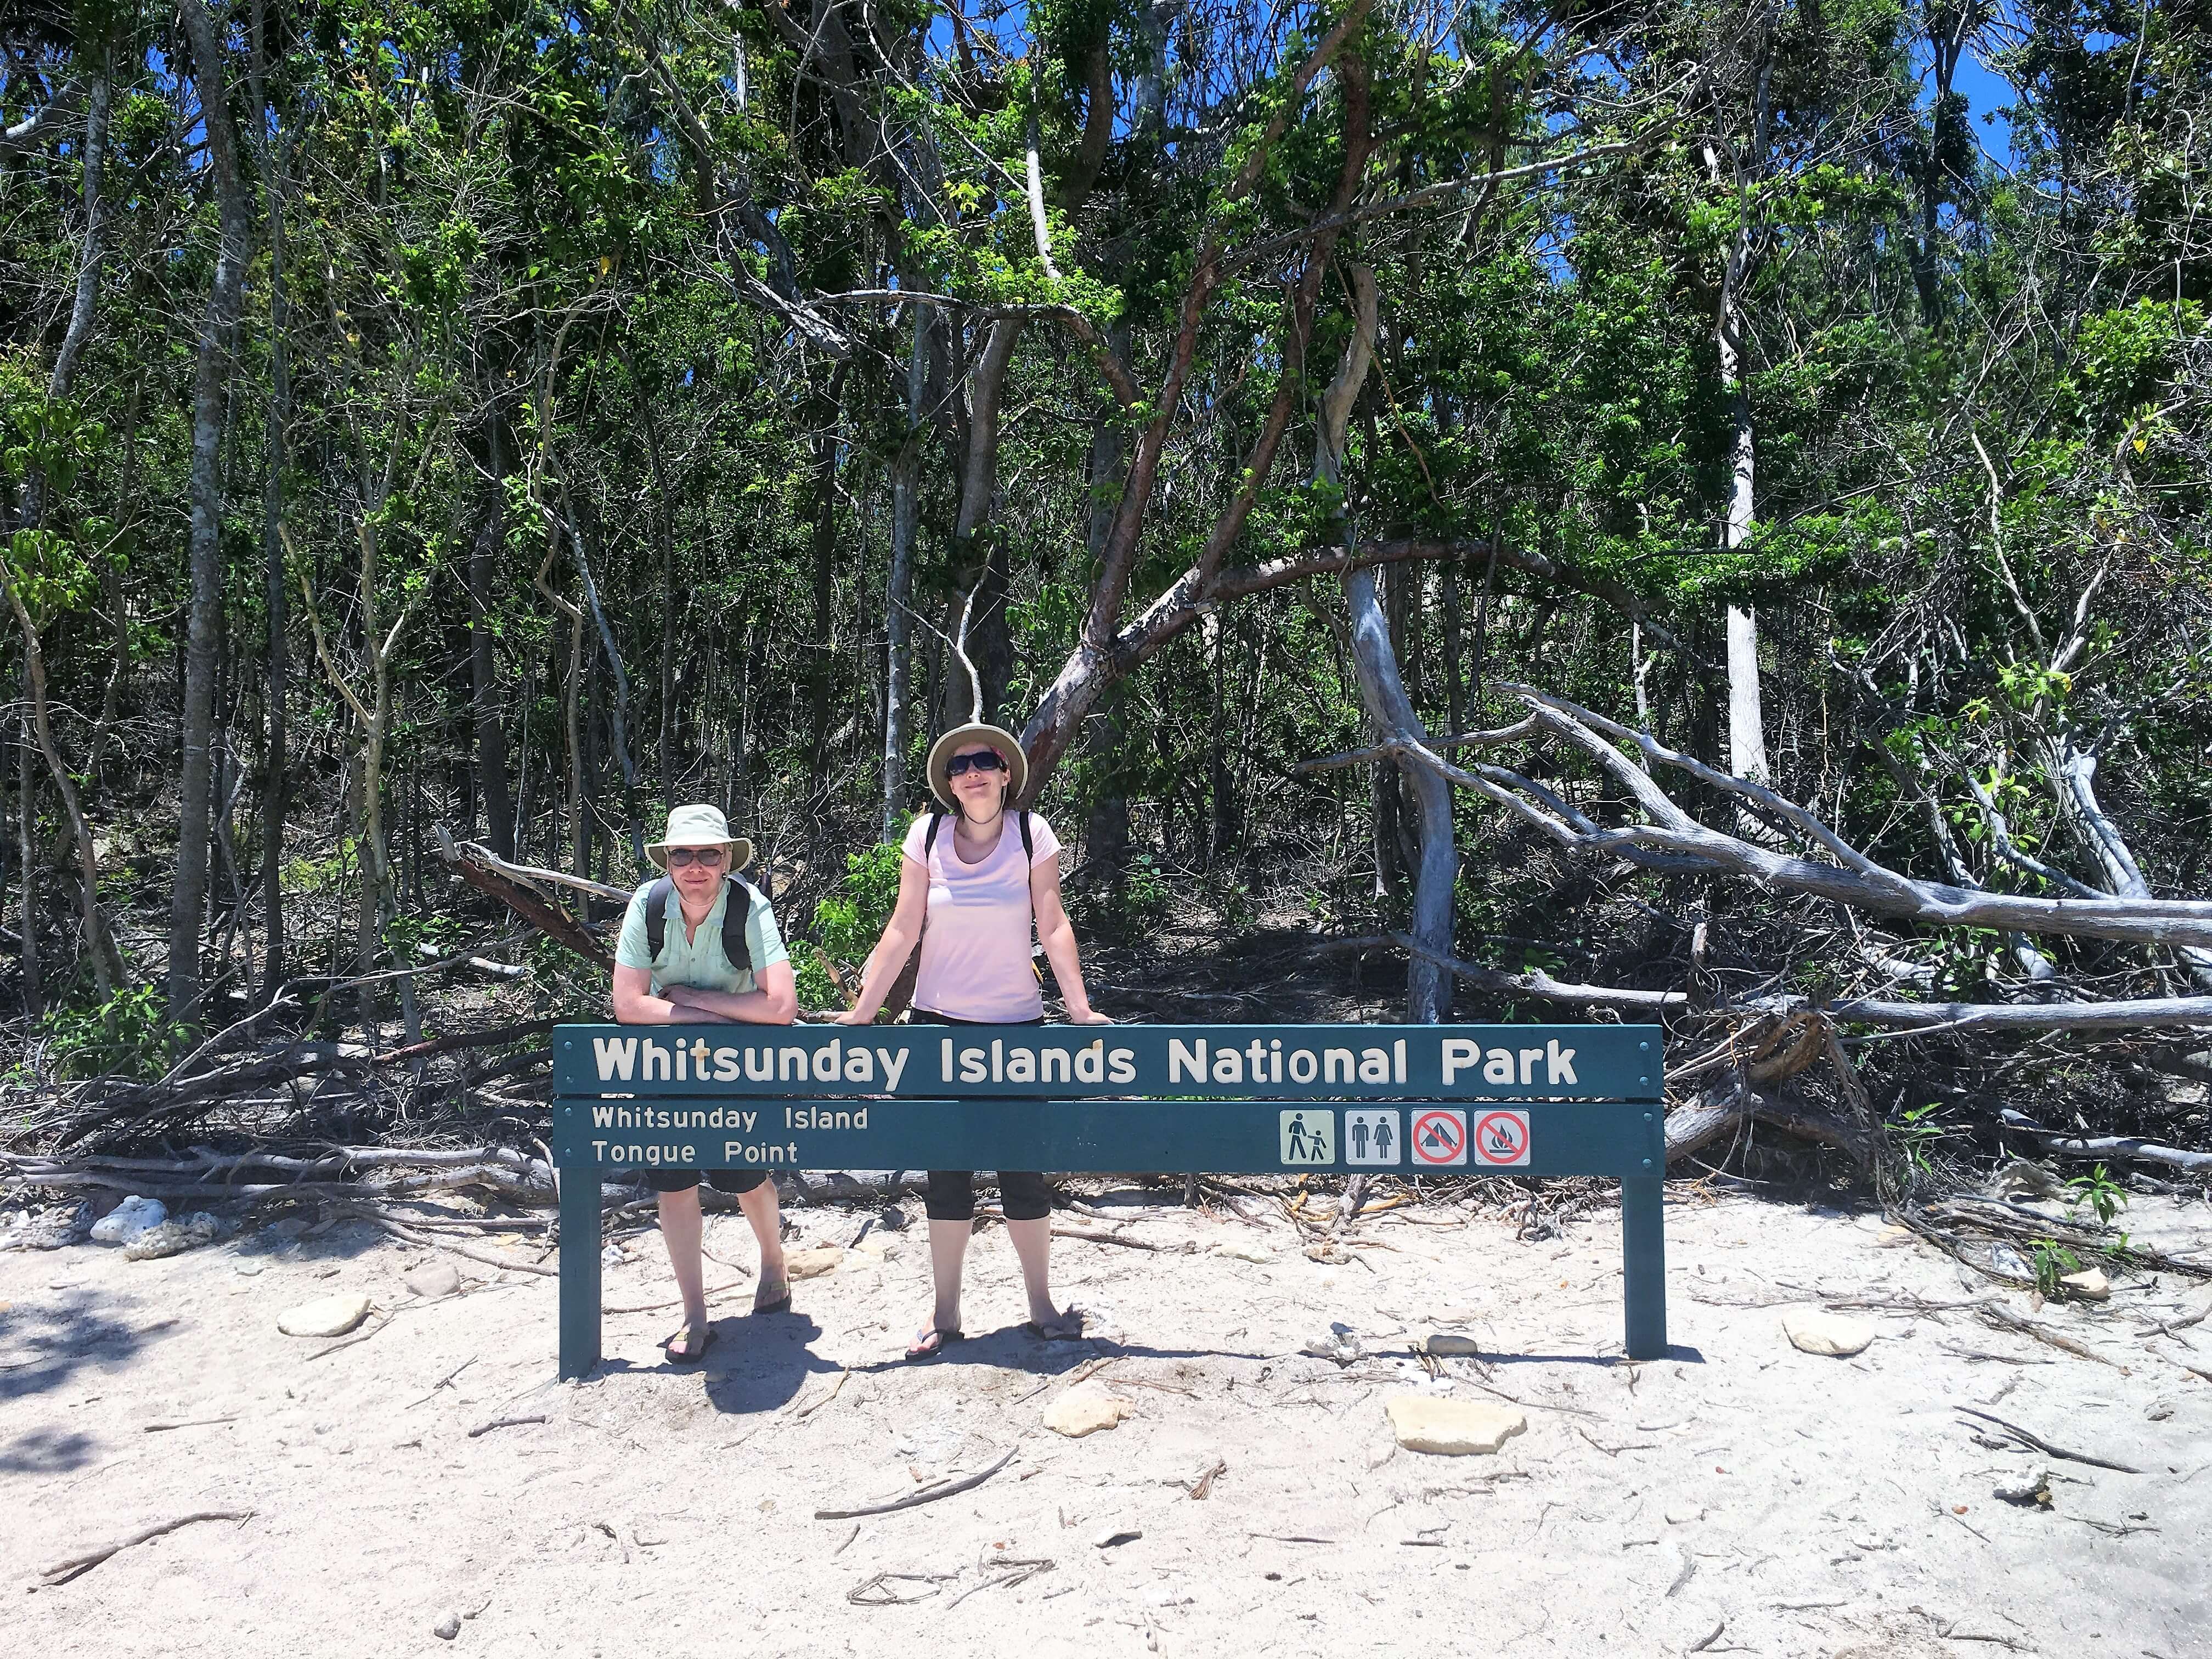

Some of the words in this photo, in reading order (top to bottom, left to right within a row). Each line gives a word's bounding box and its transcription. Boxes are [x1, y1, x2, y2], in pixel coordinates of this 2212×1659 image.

[593, 1038, 910, 1091] Whitsunday
[942, 1039, 1136, 1084] Islands
[1169, 1039, 1407, 1084] National
[1442, 1039, 1577, 1085] Park
[592, 1107, 757, 1132] Whitsunday
[786, 1107, 867, 1130] Island
[592, 1141, 696, 1165] Tongue
[725, 1141, 798, 1163] Point
